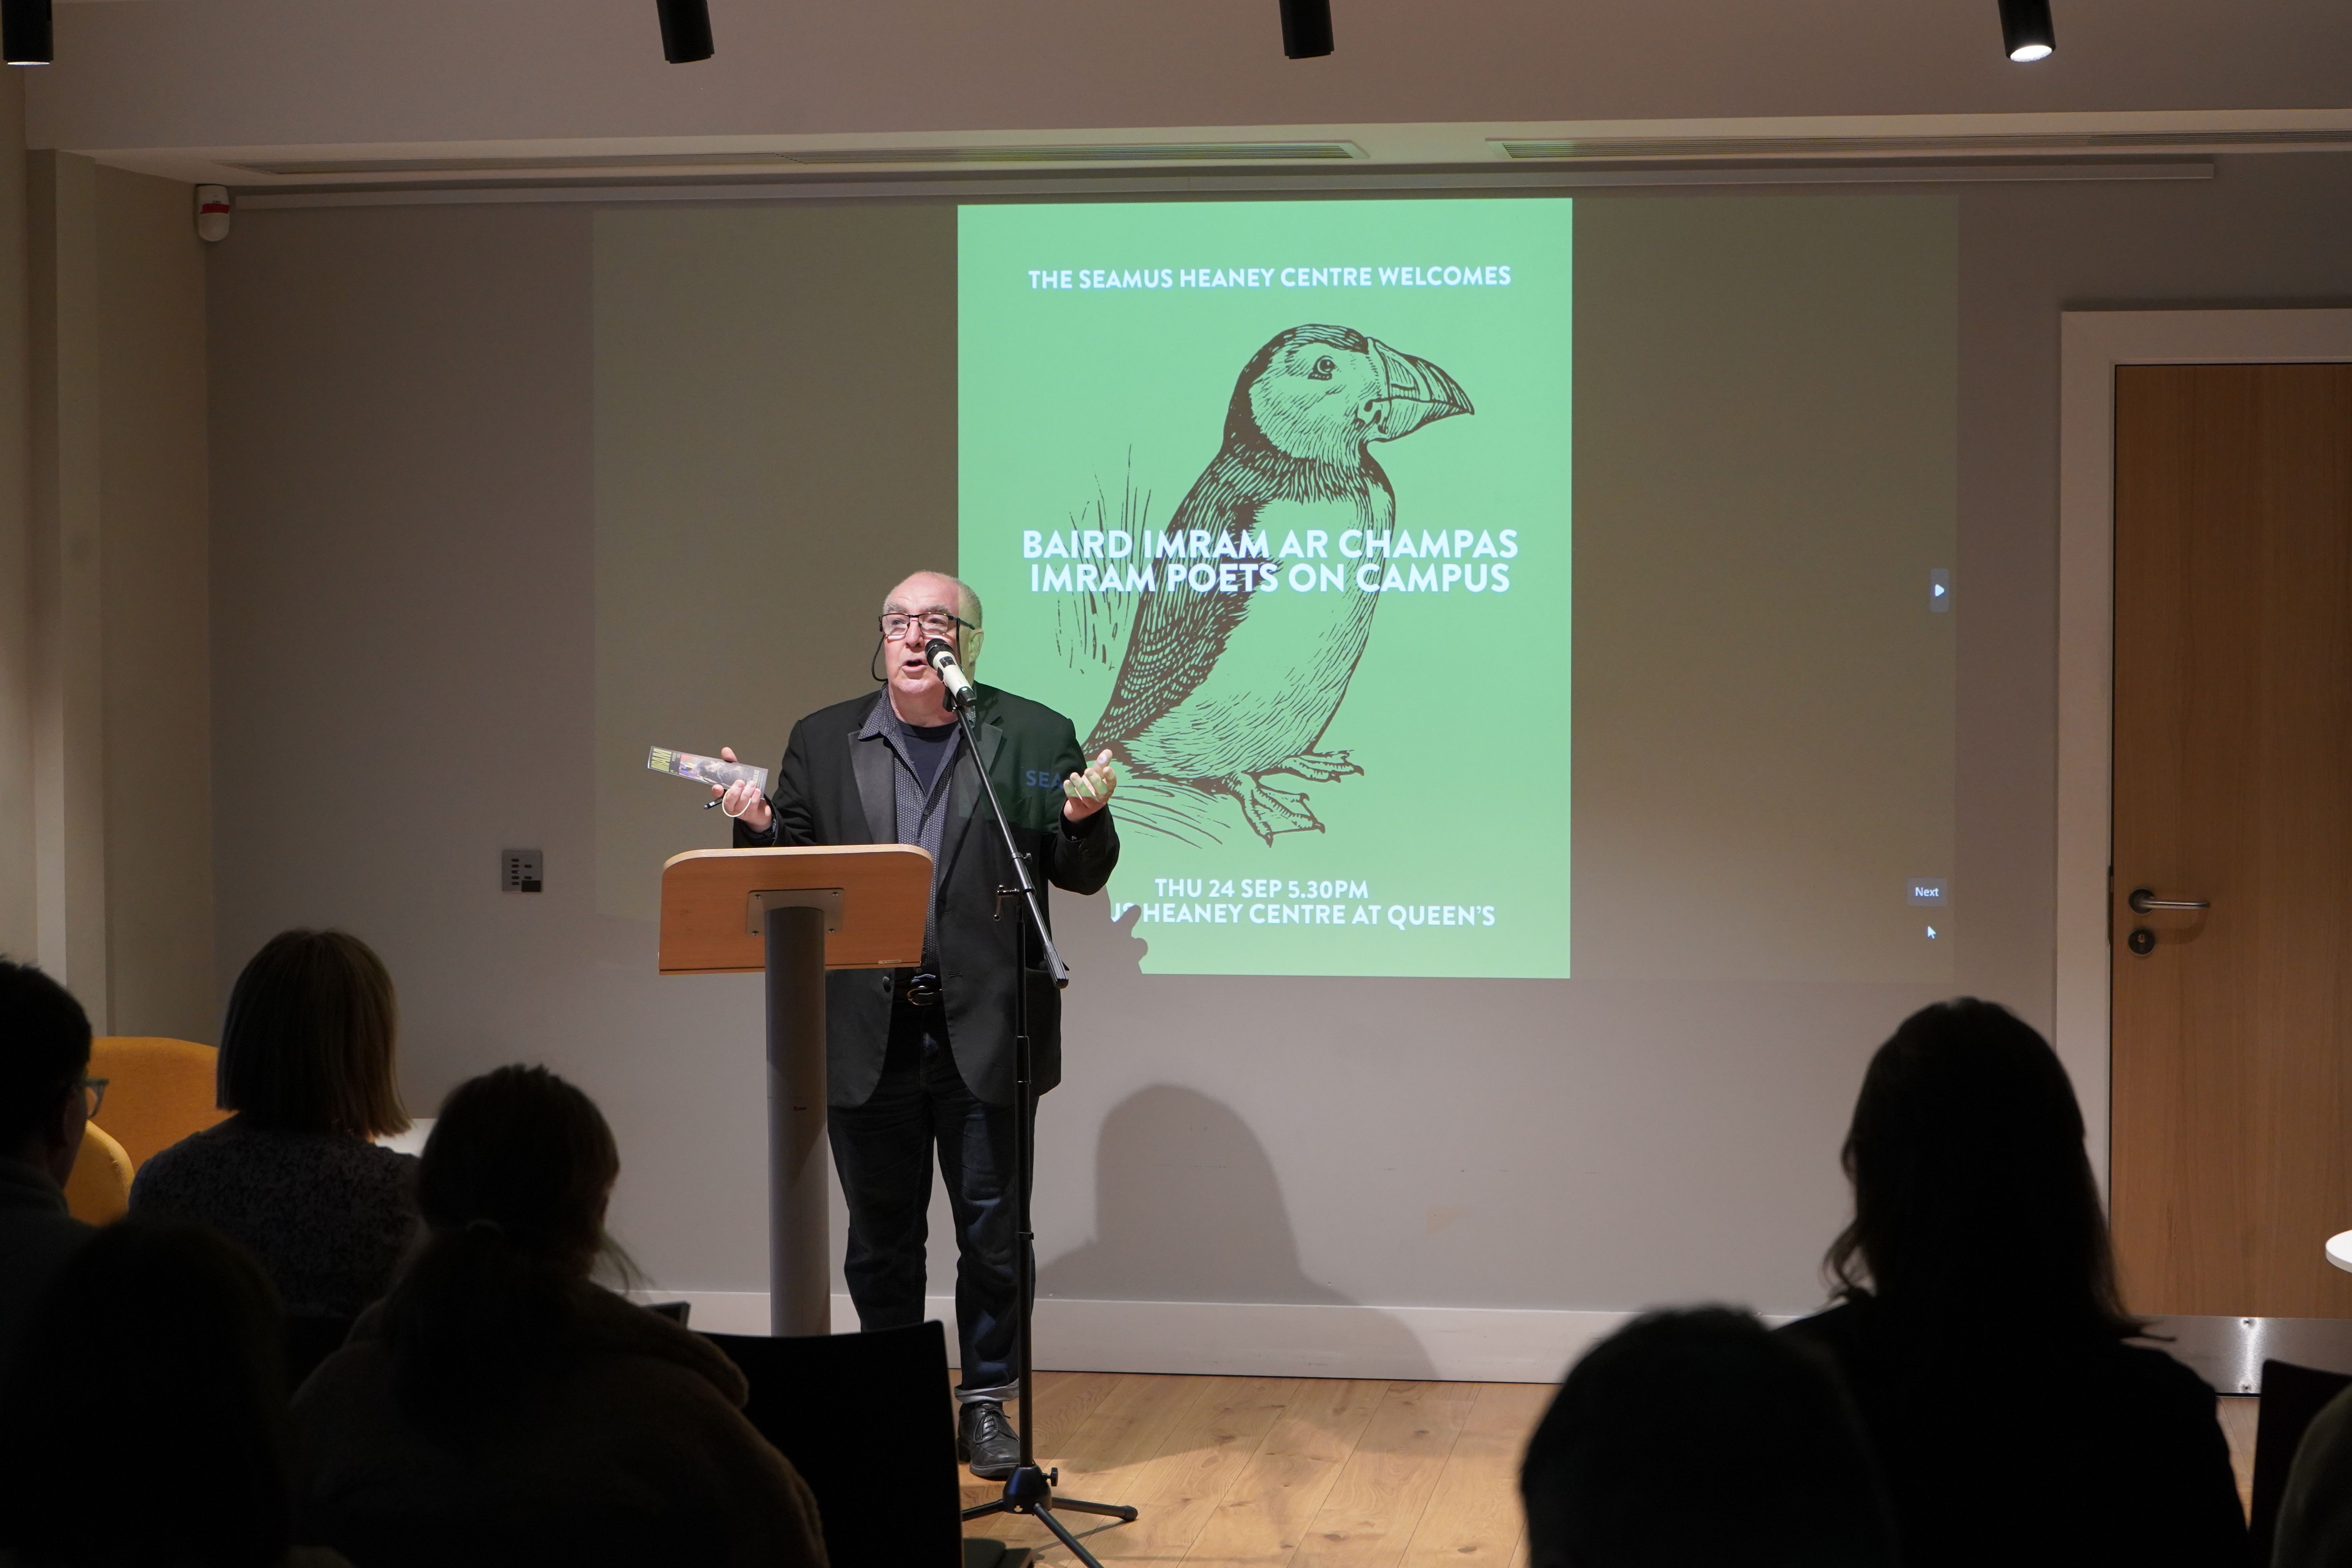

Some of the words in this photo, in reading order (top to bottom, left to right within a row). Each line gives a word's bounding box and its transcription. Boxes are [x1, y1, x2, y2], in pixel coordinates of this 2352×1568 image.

[1027, 269, 1073, 289] THE
[1079, 268, 1174, 289] SEAMUS
[1180, 268, 1276, 288] HEANEY
[1280, 267, 1372, 287] CENTRE
[1377, 265, 1512, 286] WELCOMES
[1023, 529, 1133, 559] BAIRD
[1143, 528, 1270, 559] IMRAM
[1278, 529, 1329, 559] AR
[1338, 528, 1519, 559] CHAMPAS
[1031, 563, 1156, 593] IMRAM
[1167, 562, 1279, 593] POETS
[1288, 562, 1345, 593] ON
[1356, 562, 1510, 593] CAMPUS
[1154, 878, 1203, 898] THU
[1208, 878, 1236, 898] 24
[1240, 878, 1283, 899] SEP
[1287, 879, 1369, 900] 5.30PM
[1915, 887, 1939, 897] Next
[1143, 902, 1244, 924] HEANEY
[1249, 903, 1346, 925] CENTRE
[1350, 904, 1382, 925] AT
[1387, 904, 1496, 931] QUEEN'S
